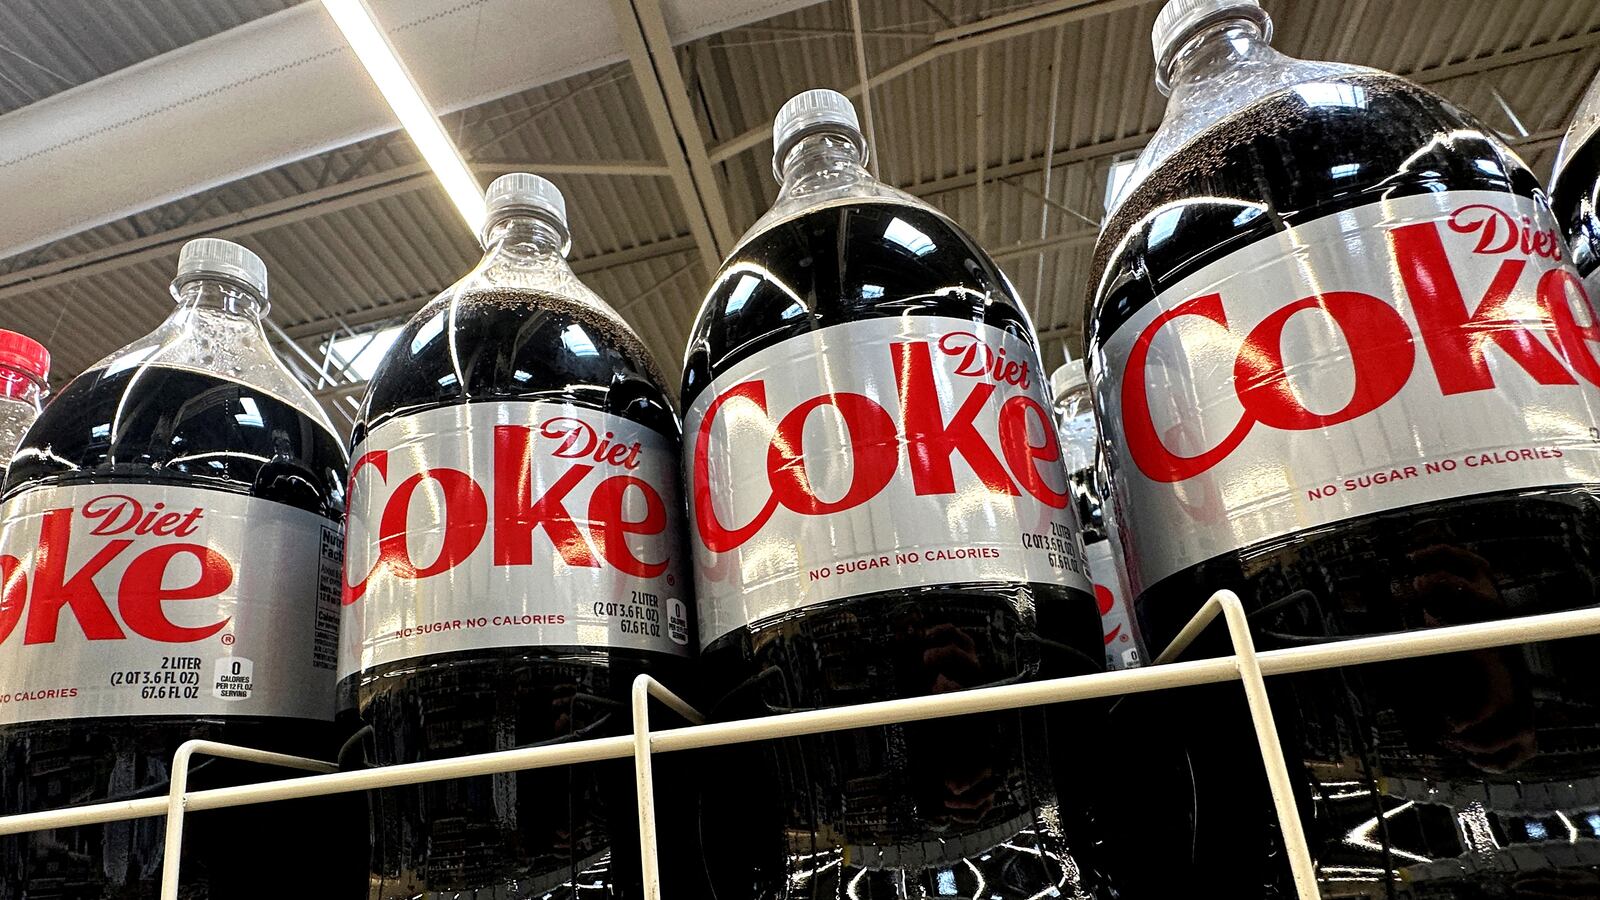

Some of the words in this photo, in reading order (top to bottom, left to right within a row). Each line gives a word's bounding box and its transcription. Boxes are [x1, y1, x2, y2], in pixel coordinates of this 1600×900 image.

[1447, 204, 1562, 261] Diet
[938, 331, 1031, 389] Diet
[1122, 222, 1600, 483] Coke
[540, 417, 642, 469] Diet
[694, 342, 1069, 553] Coke
[1307, 485, 1338, 501] NO
[1344, 466, 1419, 491] SUGAR
[1425, 459, 1457, 475] NO
[1464, 448, 1563, 467] CALORIES
[82, 494, 204, 538] Diet
[342, 425, 670, 606] Coke
[809, 567, 831, 581] NO
[836, 556, 890, 575] SUGAR
[895, 552, 919, 565] NO
[925, 548, 1000, 561] CALORIES
[632, 591, 637, 604] 2
[638, 592, 659, 608] LITER
[593, 602, 604, 617] (2
[606, 603, 618, 616] QT
[620, 604, 634, 618] 3.6
[636, 606, 644, 620] FL
[396, 628, 412, 639] NO
[416, 620, 461, 635] SUGAR
[466, 617, 487, 628] NO
[492, 615, 565, 626] CALORIES
[621, 620, 639, 634] 67.6
[640, 622, 649, 635] FL
[650, 624, 660, 637] OZ
[161, 657, 169, 670] 2
[171, 657, 201, 670] LITER
[231, 661, 241, 675] 0
[110, 671, 124, 686] (2
[125, 671, 141, 685] QT
[142, 671, 161, 684] 3.6
[164, 671, 176, 684] FL
[179, 671, 200, 686] OZ)
[215, 682, 229, 690] PER
[220, 675, 250, 683] CALORIES
[15, 688, 78, 702] CALORIES
[141, 686, 166, 699] 67.6
[168, 686, 180, 699] FL
[183, 686, 199, 699] OZ
